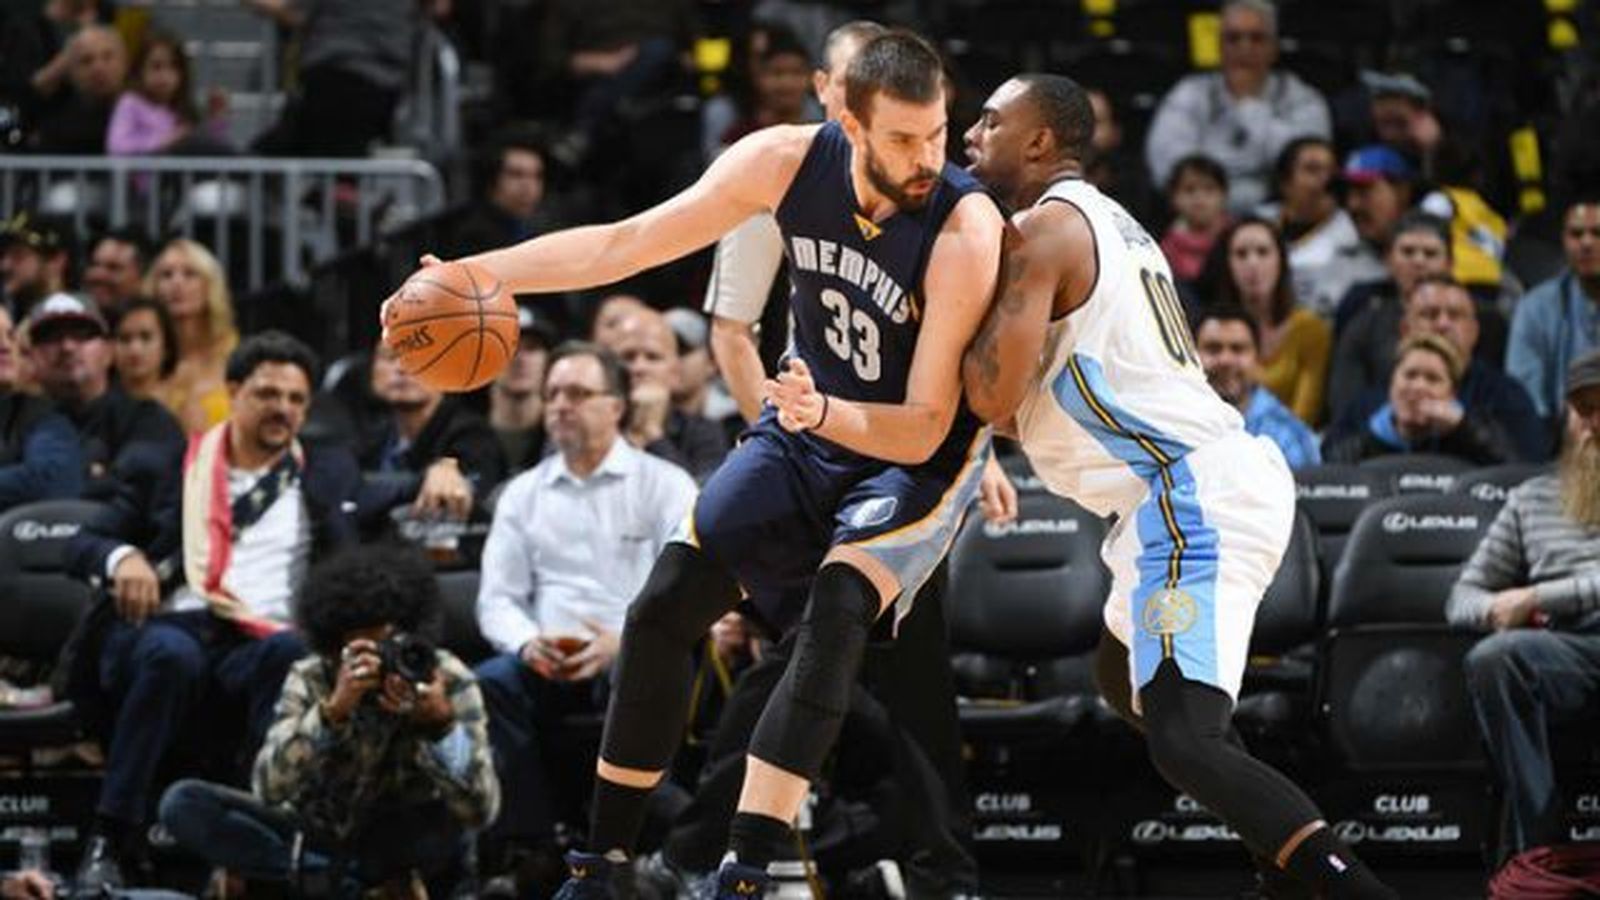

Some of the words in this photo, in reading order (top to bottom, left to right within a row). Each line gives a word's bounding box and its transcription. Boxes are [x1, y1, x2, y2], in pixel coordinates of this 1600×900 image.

[791, 236, 911, 324] MEMPHIS
[820, 288, 881, 382] 33
[1410, 515, 1478, 529] LEXUS
[975, 795, 1031, 811] CLUB
[1375, 795, 1430, 812] CLUB
[1368, 825, 1461, 841] LEXUS
